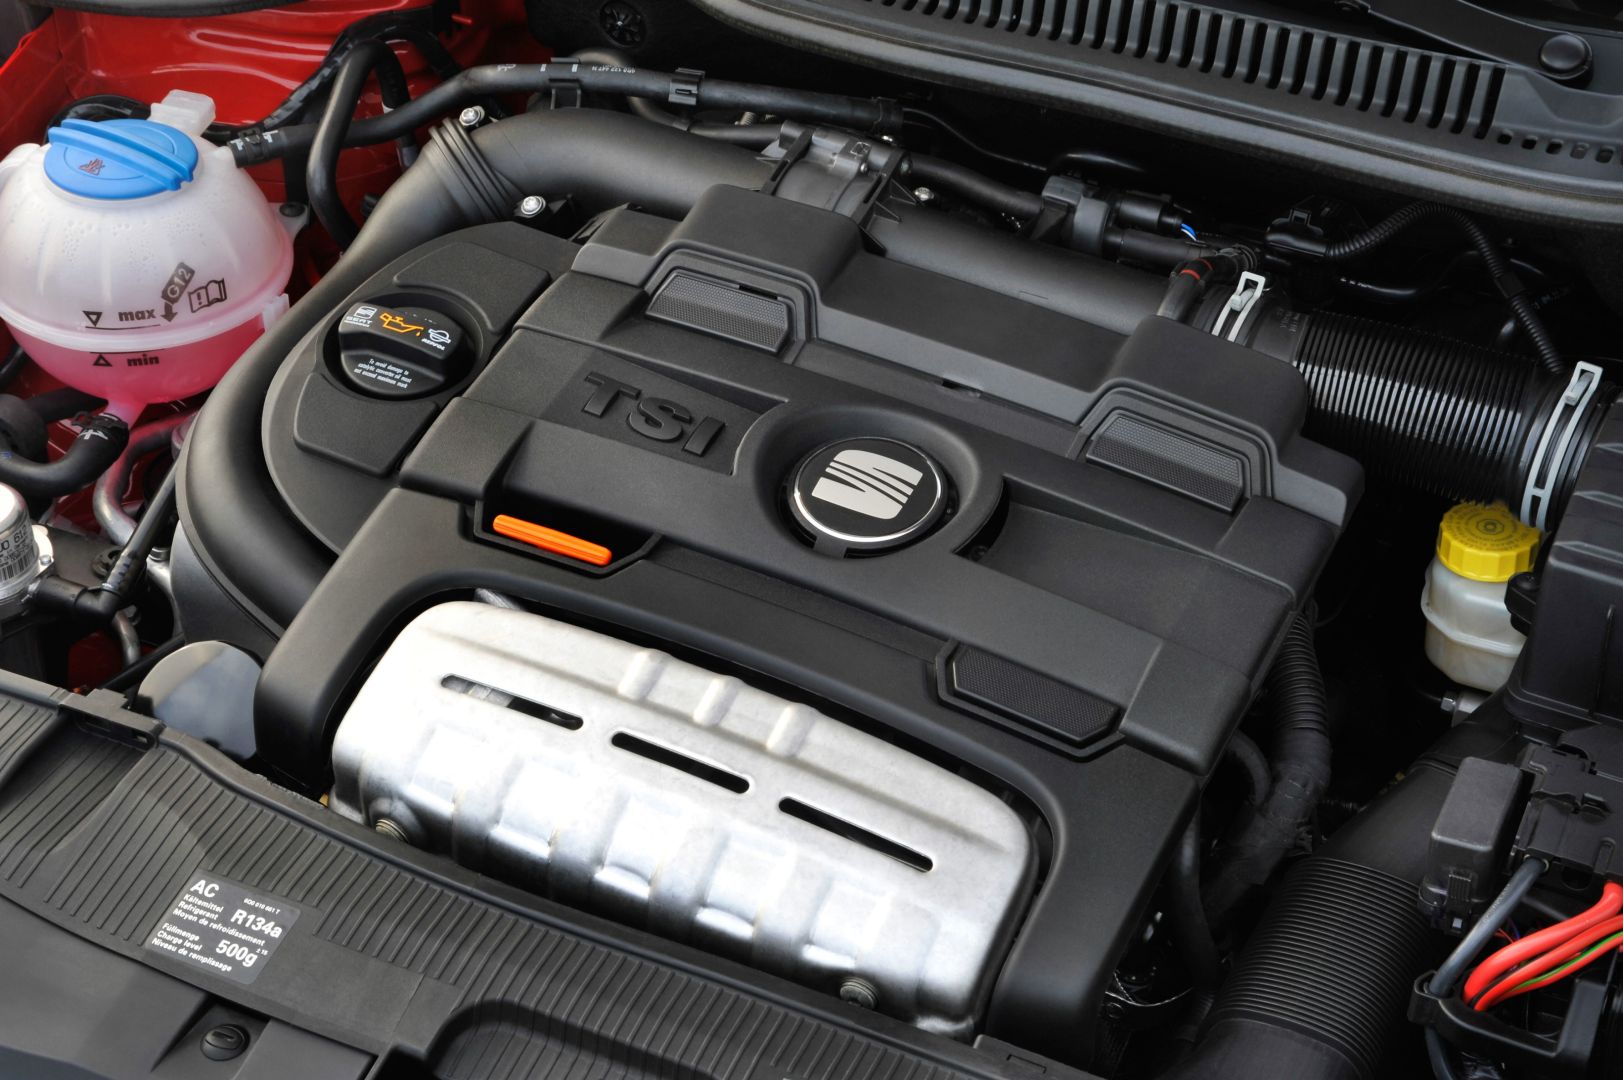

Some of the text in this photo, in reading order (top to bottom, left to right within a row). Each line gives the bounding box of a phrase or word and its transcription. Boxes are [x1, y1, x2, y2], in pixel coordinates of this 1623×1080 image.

[166, 267, 192, 299] G12
[118, 308, 156, 322] max
[127, 354, 160, 367] min
[581, 371, 726, 458] TSI
[190, 879, 219, 898] AC
[178, 901, 219, 921] Refrigerant
[183, 894, 224, 913] Kältemittel
[162, 922, 200, 941] Füllmenge
[172, 908, 266, 946] Moyen de refroidissement
[230, 909, 283, 938] R134a
[157, 930, 203, 951] Charge level
[151, 937, 233, 972] Niveau de remplissage
[215, 939, 258, 968] 500g
